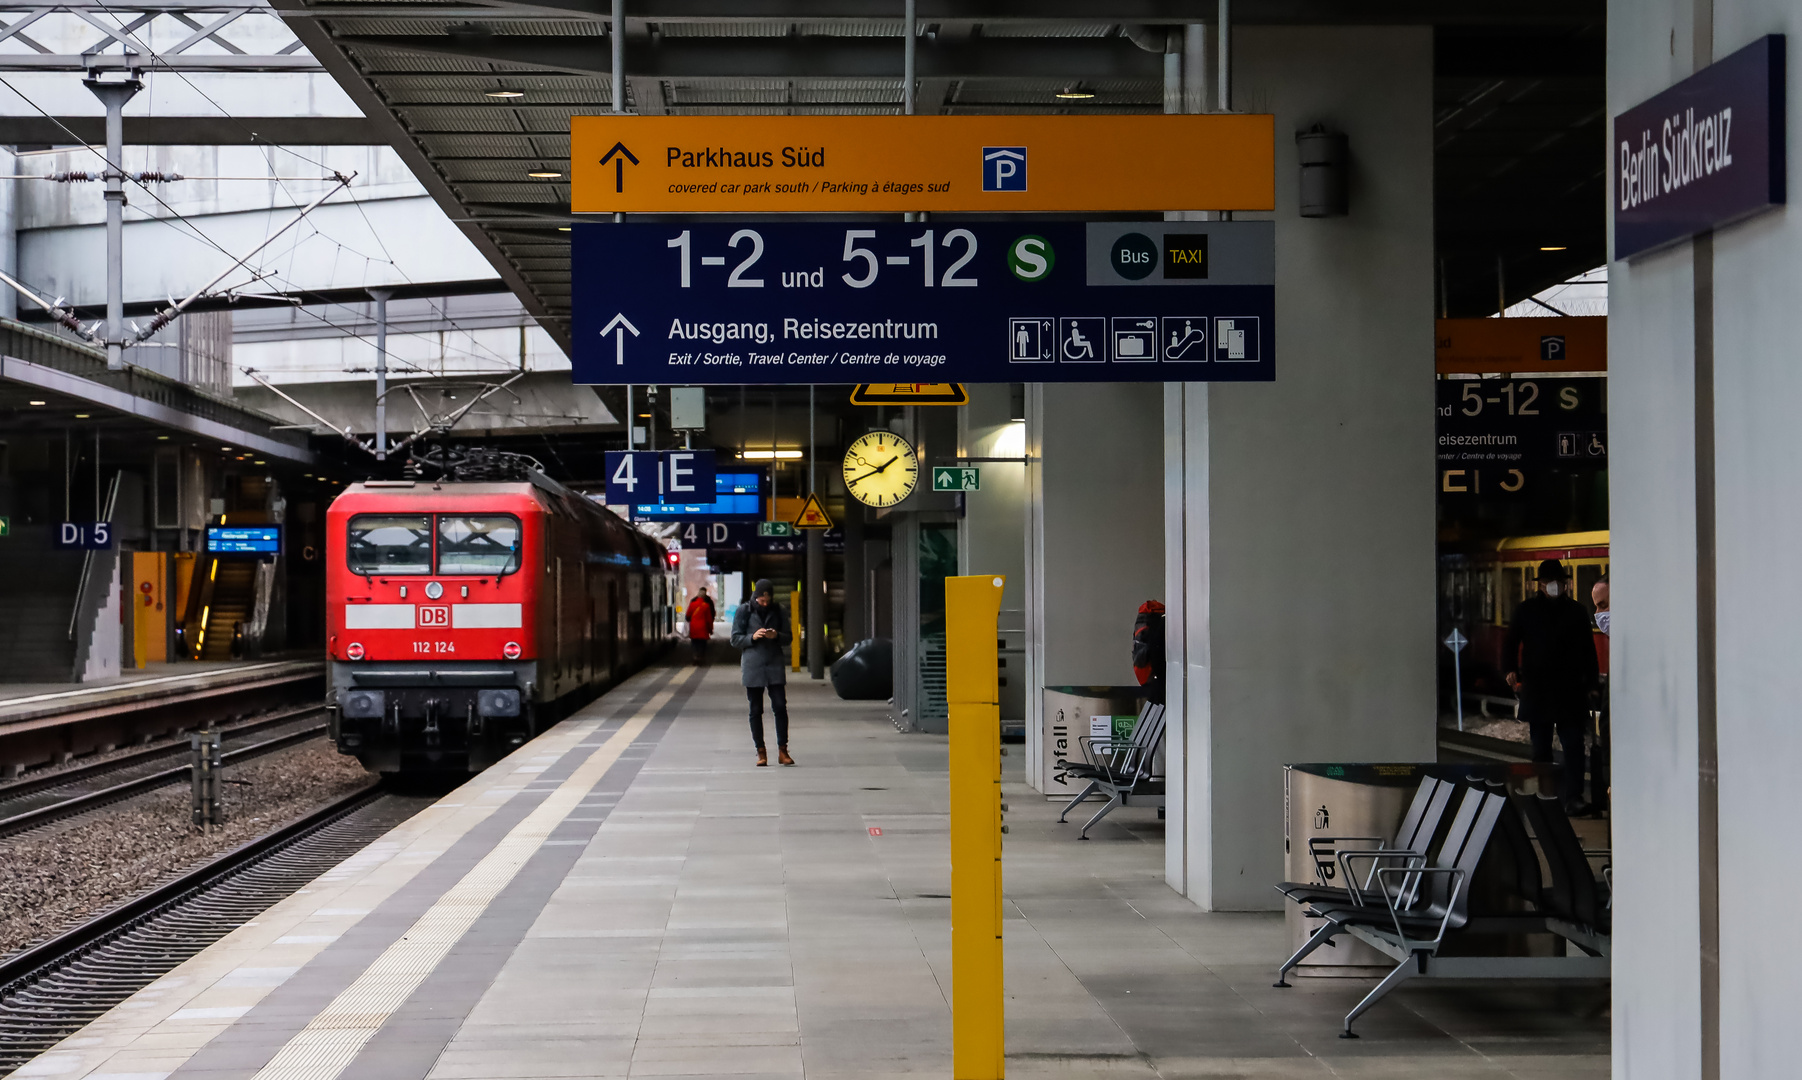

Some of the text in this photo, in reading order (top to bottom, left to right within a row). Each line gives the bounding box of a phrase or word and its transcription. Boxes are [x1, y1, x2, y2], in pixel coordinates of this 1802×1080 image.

[667, 145, 825, 168] Parkhaus Süd
[1621, 107, 1732, 211] Berlin Südkreuz
[668, 180, 951, 196] covered car park south / Parking à étages sud
[667, 229, 979, 288] 1-2 und 5-12
[1015, 238, 1047, 278] S
[1120, 249, 1150, 264] Bus
[1169, 249, 1202, 264] TAXI
[667, 317, 938, 345] Ausgang, Reisezentrum
[668, 352, 692, 365] Exit
[703, 352, 743, 367] Sortie,
[748, 352, 785, 365] Travel
[787, 352, 828, 365] Center
[840, 352, 881, 365] Centre
[883, 352, 900, 365] de
[903, 354, 947, 367] voyage
[1461, 381, 1540, 417] 5-12
[1461, 452, 1485, 460] Centre
[1497, 453, 1522, 461] voyage
[612, 453, 695, 493] 4 E
[61, 523, 109, 544] D 5
[683, 522, 728, 544] 4 D
[421, 608, 446, 624] DB
[412, 641, 455, 653] 112 124
